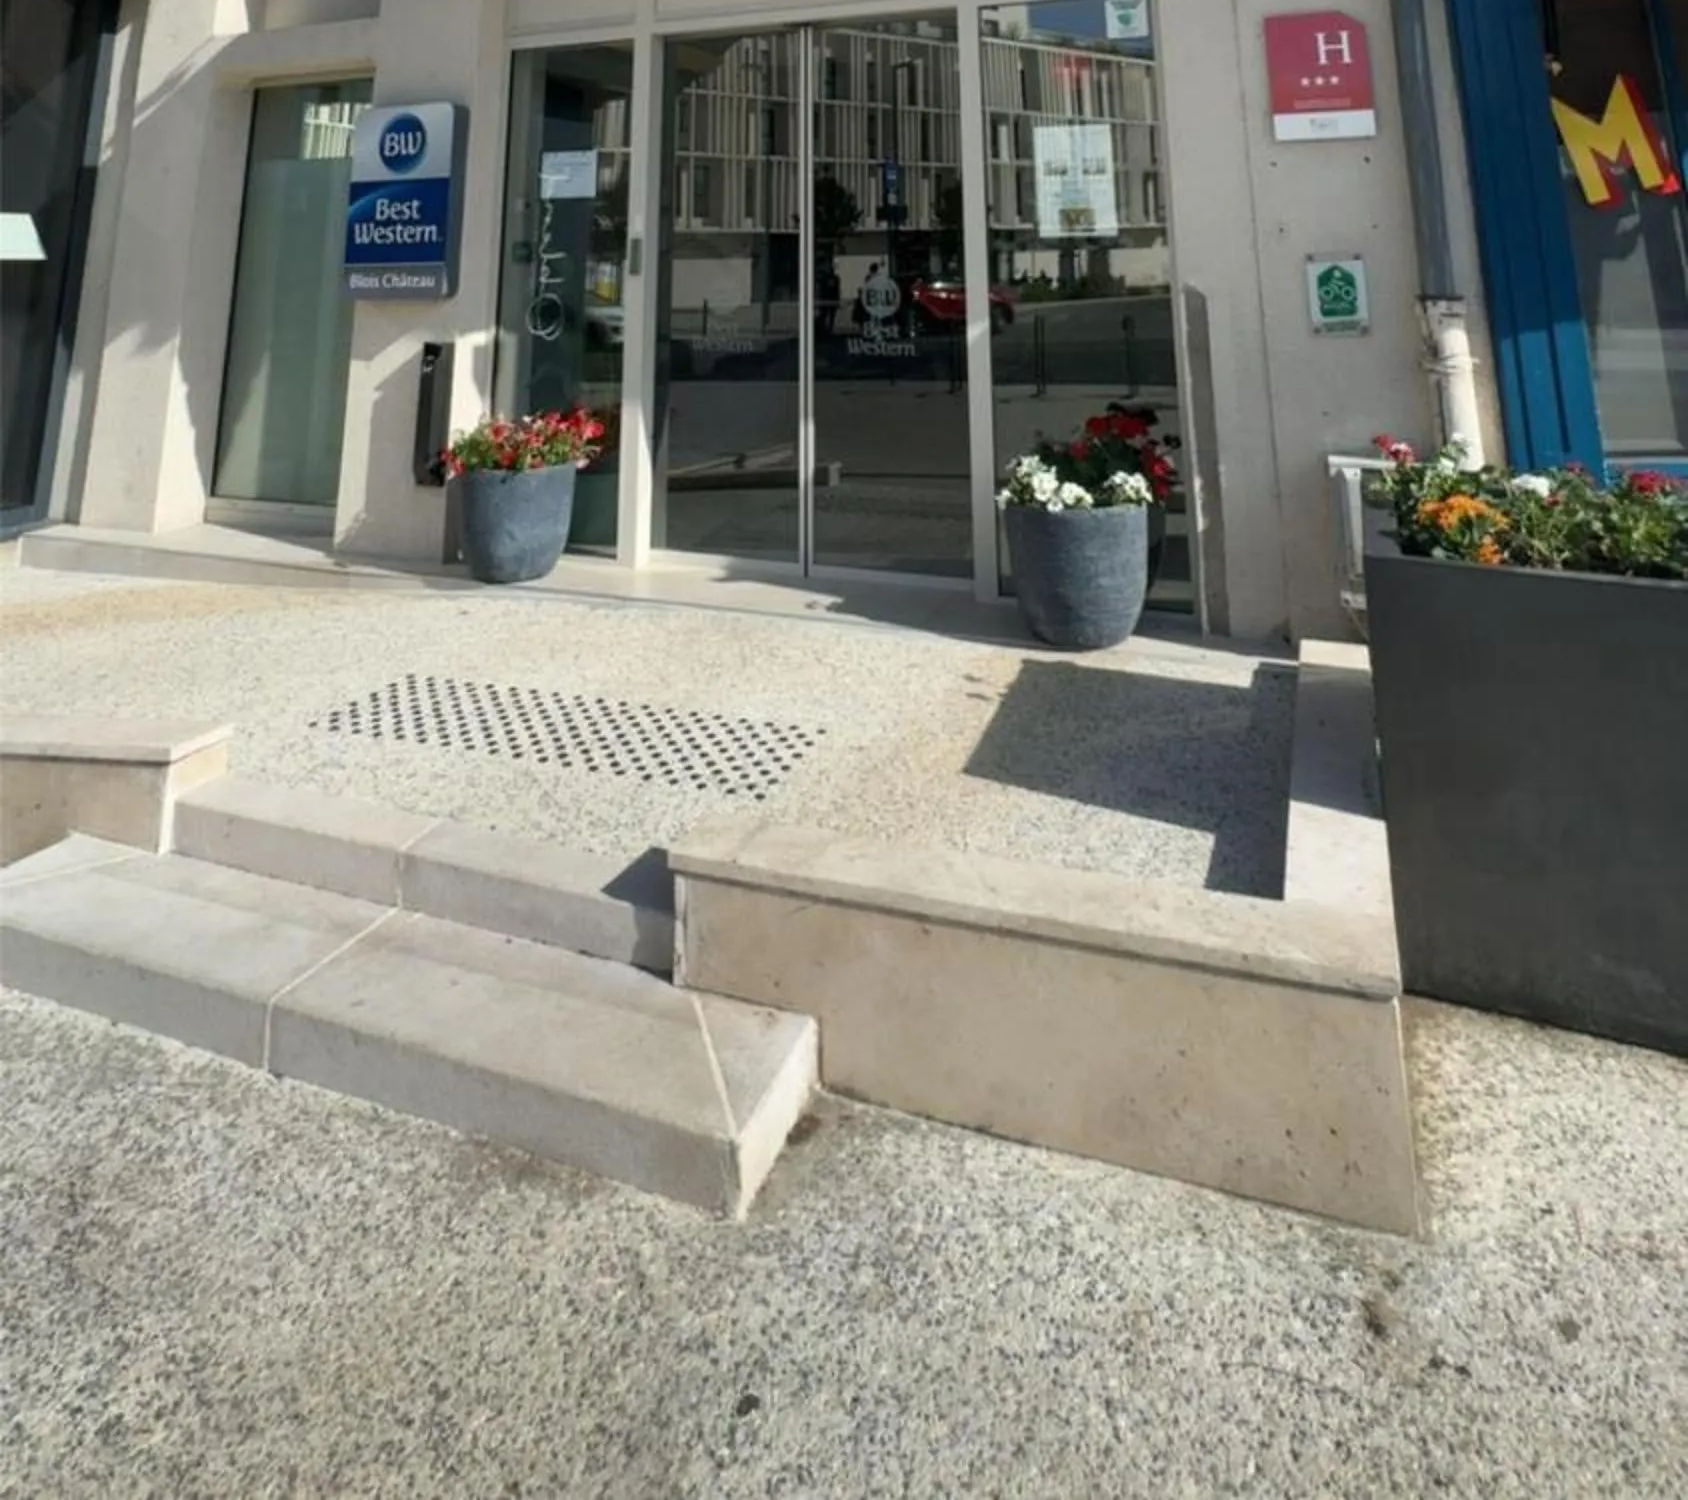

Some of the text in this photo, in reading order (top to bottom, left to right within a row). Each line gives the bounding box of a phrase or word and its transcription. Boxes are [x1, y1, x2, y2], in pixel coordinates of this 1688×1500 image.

[1314, 29, 1355, 65] H
[383, 131, 421, 158] BW
[1550, 73, 1680, 206] M
[375, 197, 422, 220] Best
[353, 221, 437, 245] Western
[350, 271, 436, 289] Blois Château
[866, 289, 898, 307] BW
[863, 321, 900, 339] Best
[847, 338, 916, 357] Western
